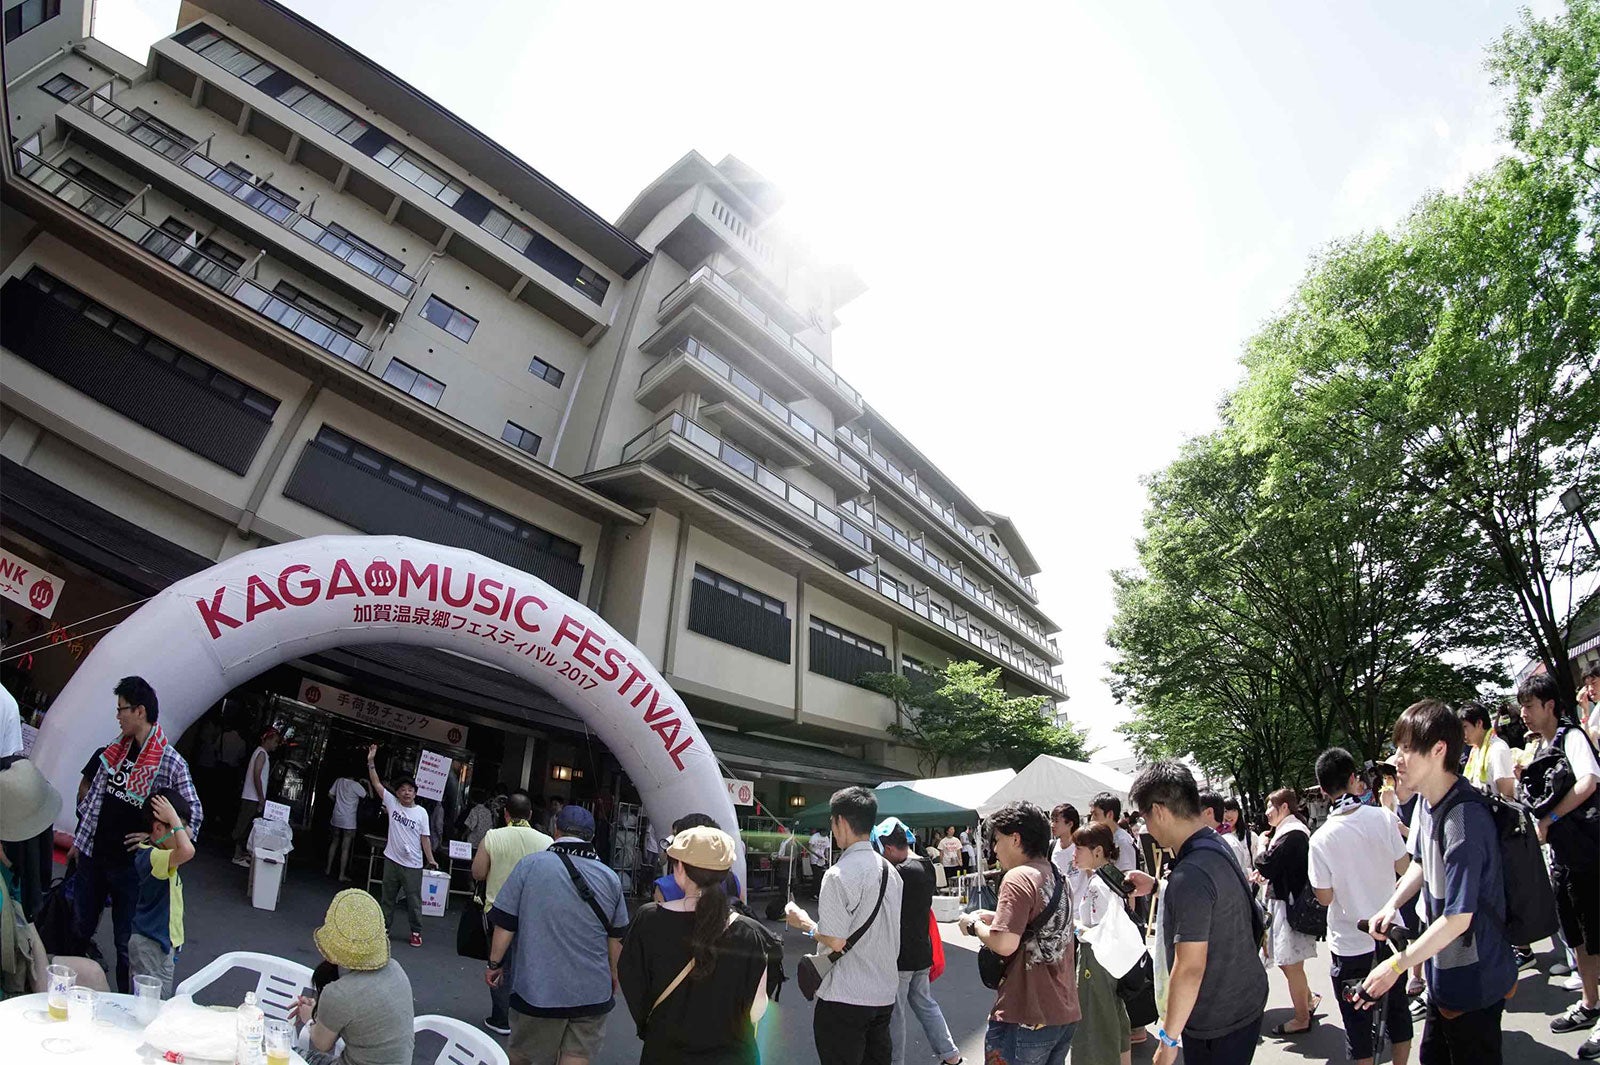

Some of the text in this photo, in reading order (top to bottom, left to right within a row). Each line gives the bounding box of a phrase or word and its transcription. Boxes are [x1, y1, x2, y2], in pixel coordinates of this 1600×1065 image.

[196, 558, 695, 770] KAGA MUSIC FESTIVAL
[353, 603, 599, 690] 加賀温泉郷フェスティバル 2017
[337, 693, 431, 730] 手荷物チェック
[391, 810, 416, 829] PEANUTS
